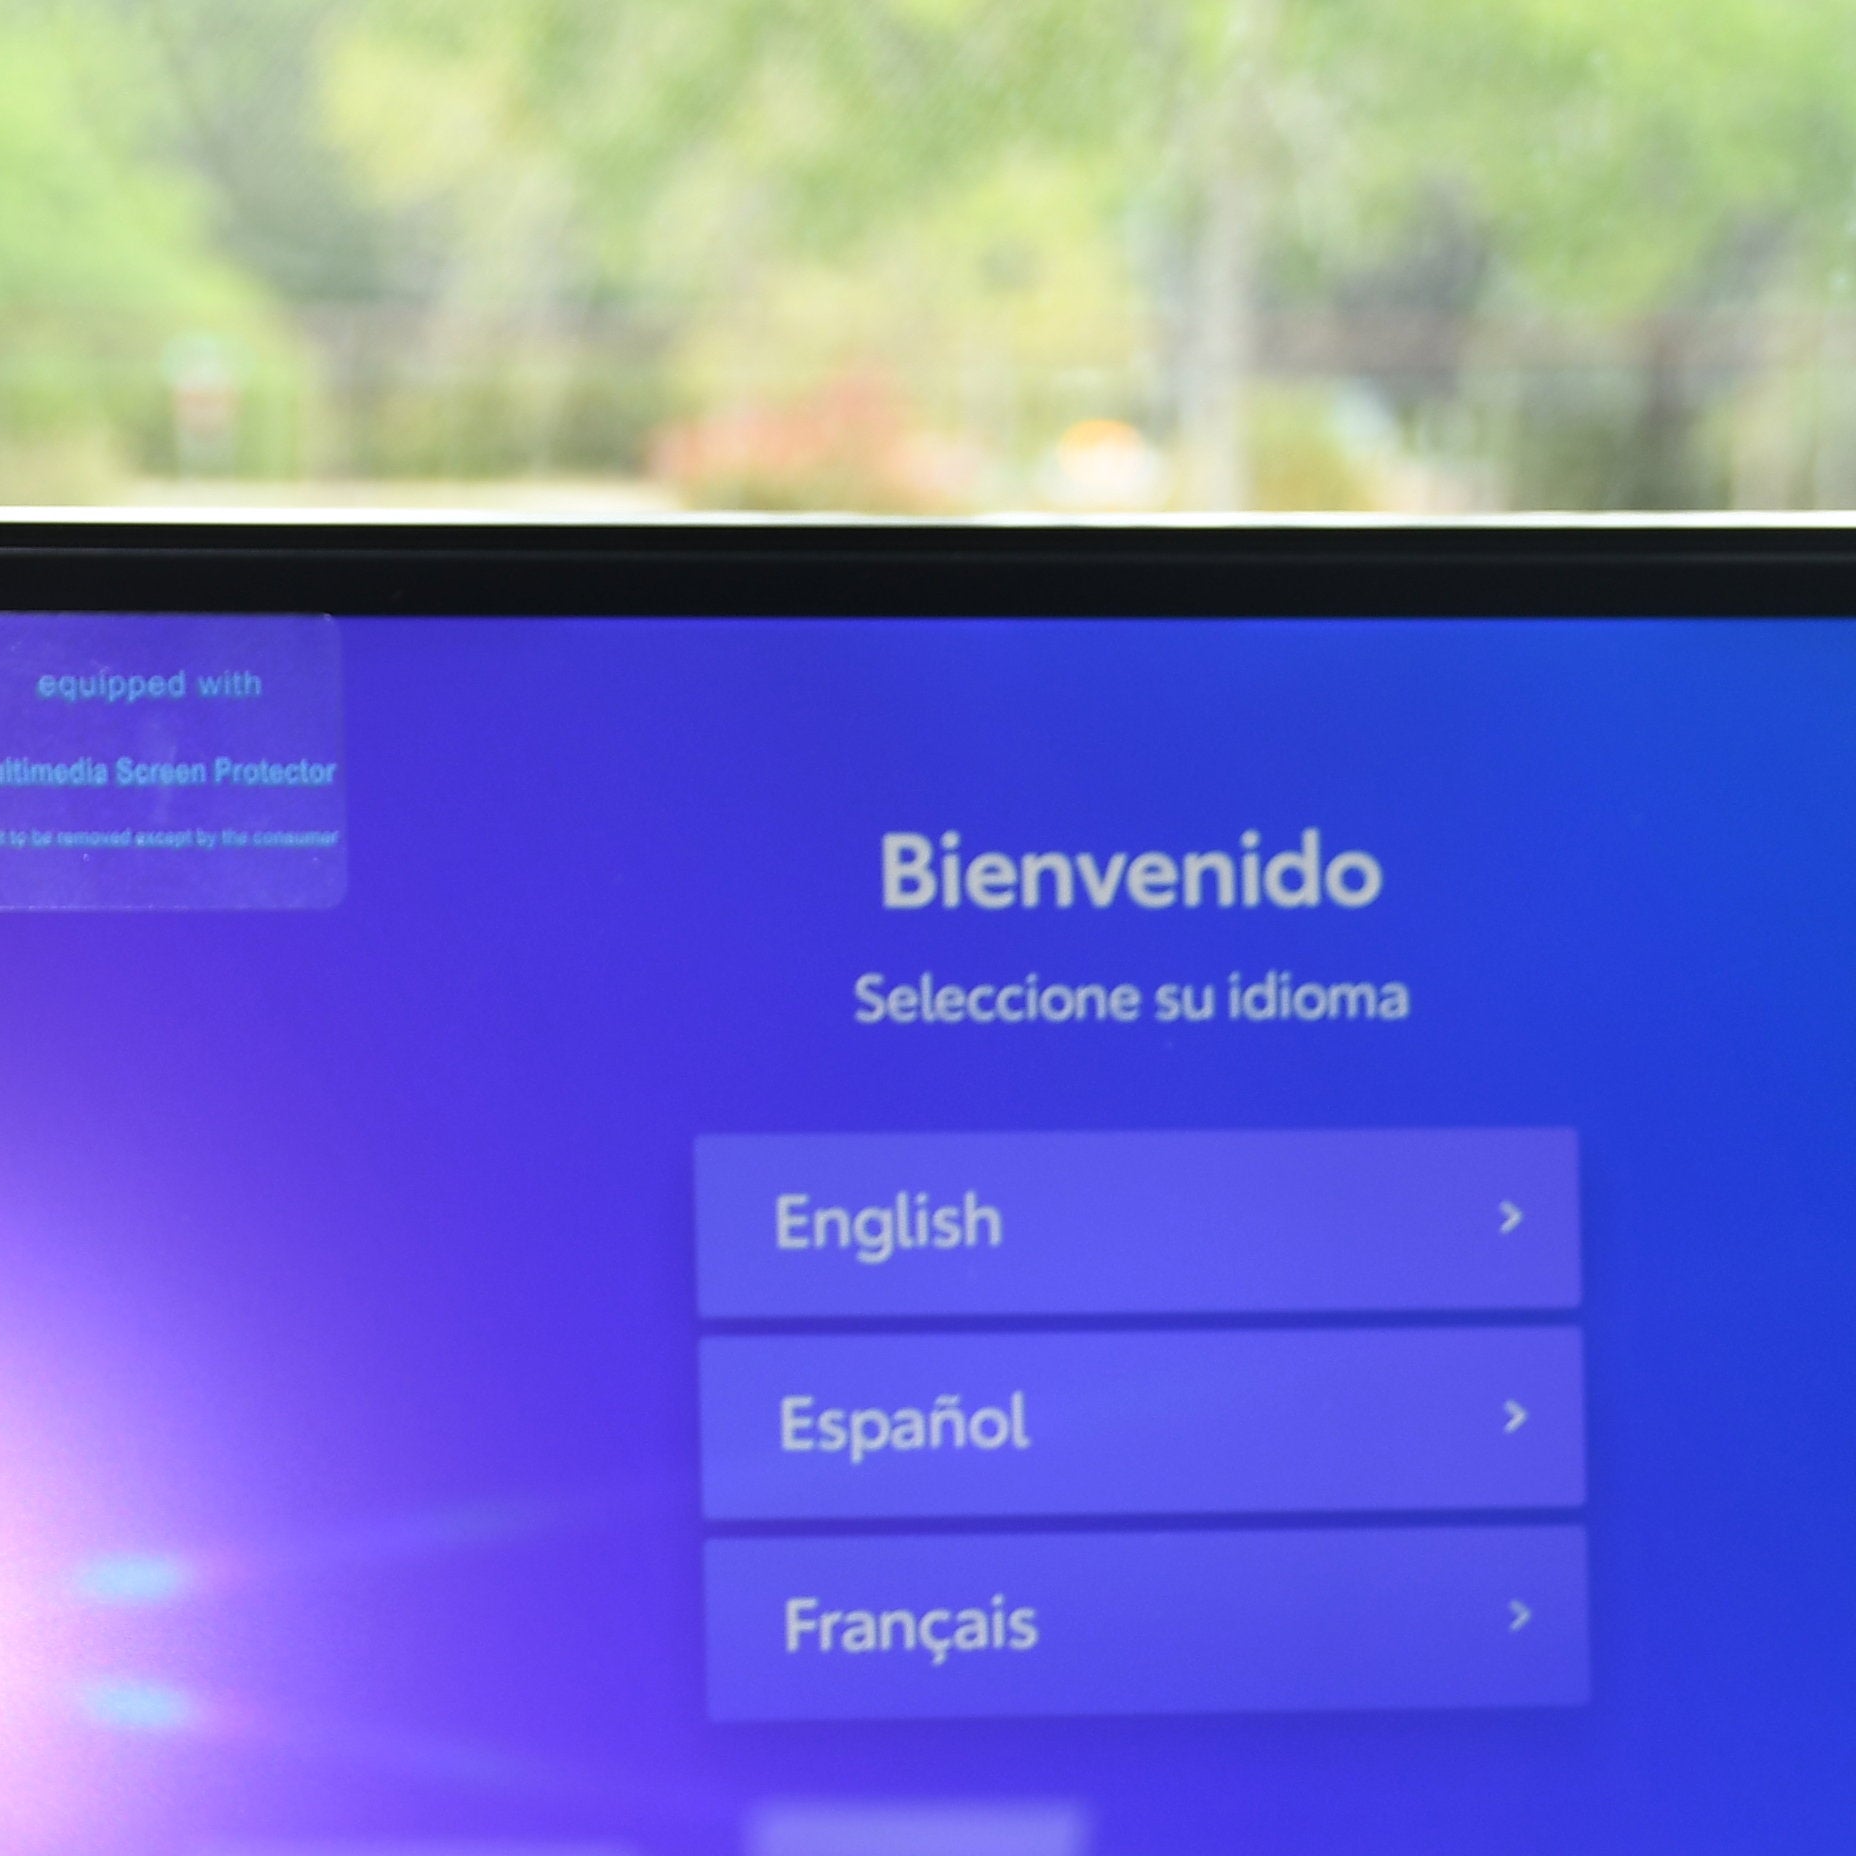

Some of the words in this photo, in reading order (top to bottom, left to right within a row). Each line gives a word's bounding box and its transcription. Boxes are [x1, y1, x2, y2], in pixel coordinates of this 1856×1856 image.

[37, 670, 186, 702] equipped
[198, 671, 262, 698] with
[115, 757, 206, 786] Screen
[214, 757, 337, 786] Protector
[196, 828, 216, 850] by
[882, 827, 1384, 909] Bienvenido
[853, 970, 1141, 1024] Seleccione
[1154, 979, 1214, 1023] su
[1229, 968, 1409, 1022] idioma
[774, 1190, 1003, 1265] English
[779, 1390, 1031, 1465] Español
[784, 1593, 1039, 1668] Français
